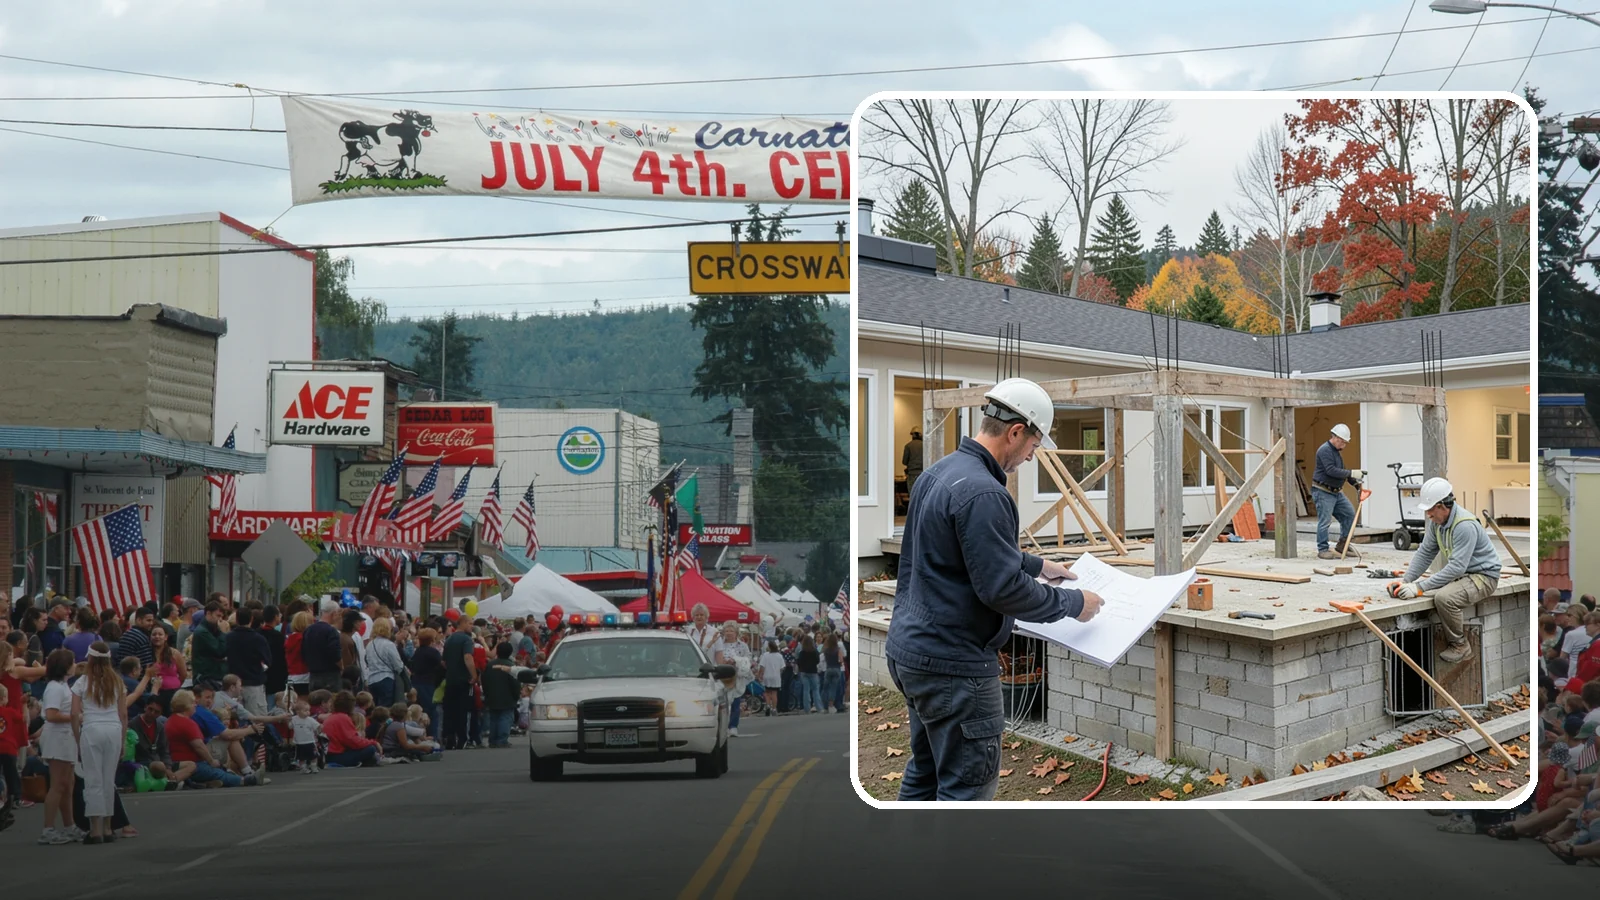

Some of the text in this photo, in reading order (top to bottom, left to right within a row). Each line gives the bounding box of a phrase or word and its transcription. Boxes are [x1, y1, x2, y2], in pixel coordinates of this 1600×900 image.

[695, 121, 850, 149] Carnat
[481, 141, 605, 192] JULY
[632, 149, 746, 197] 4th.
[697, 254, 850, 279] CROSSWA
[282, 380, 373, 419] ACE
[406, 409, 485, 421] CEDAR LOG
[283, 421, 370, 436] Hardware
[416, 428, 477, 447] Coca-Cola
[353, 467, 386, 481] Simpl
[83, 485, 155, 495] St. Vincent de Paul
[212, 517, 330, 536] HARDARE
[688, 526, 741, 535] CRNATION
[699, 535, 730, 543] GLASS
